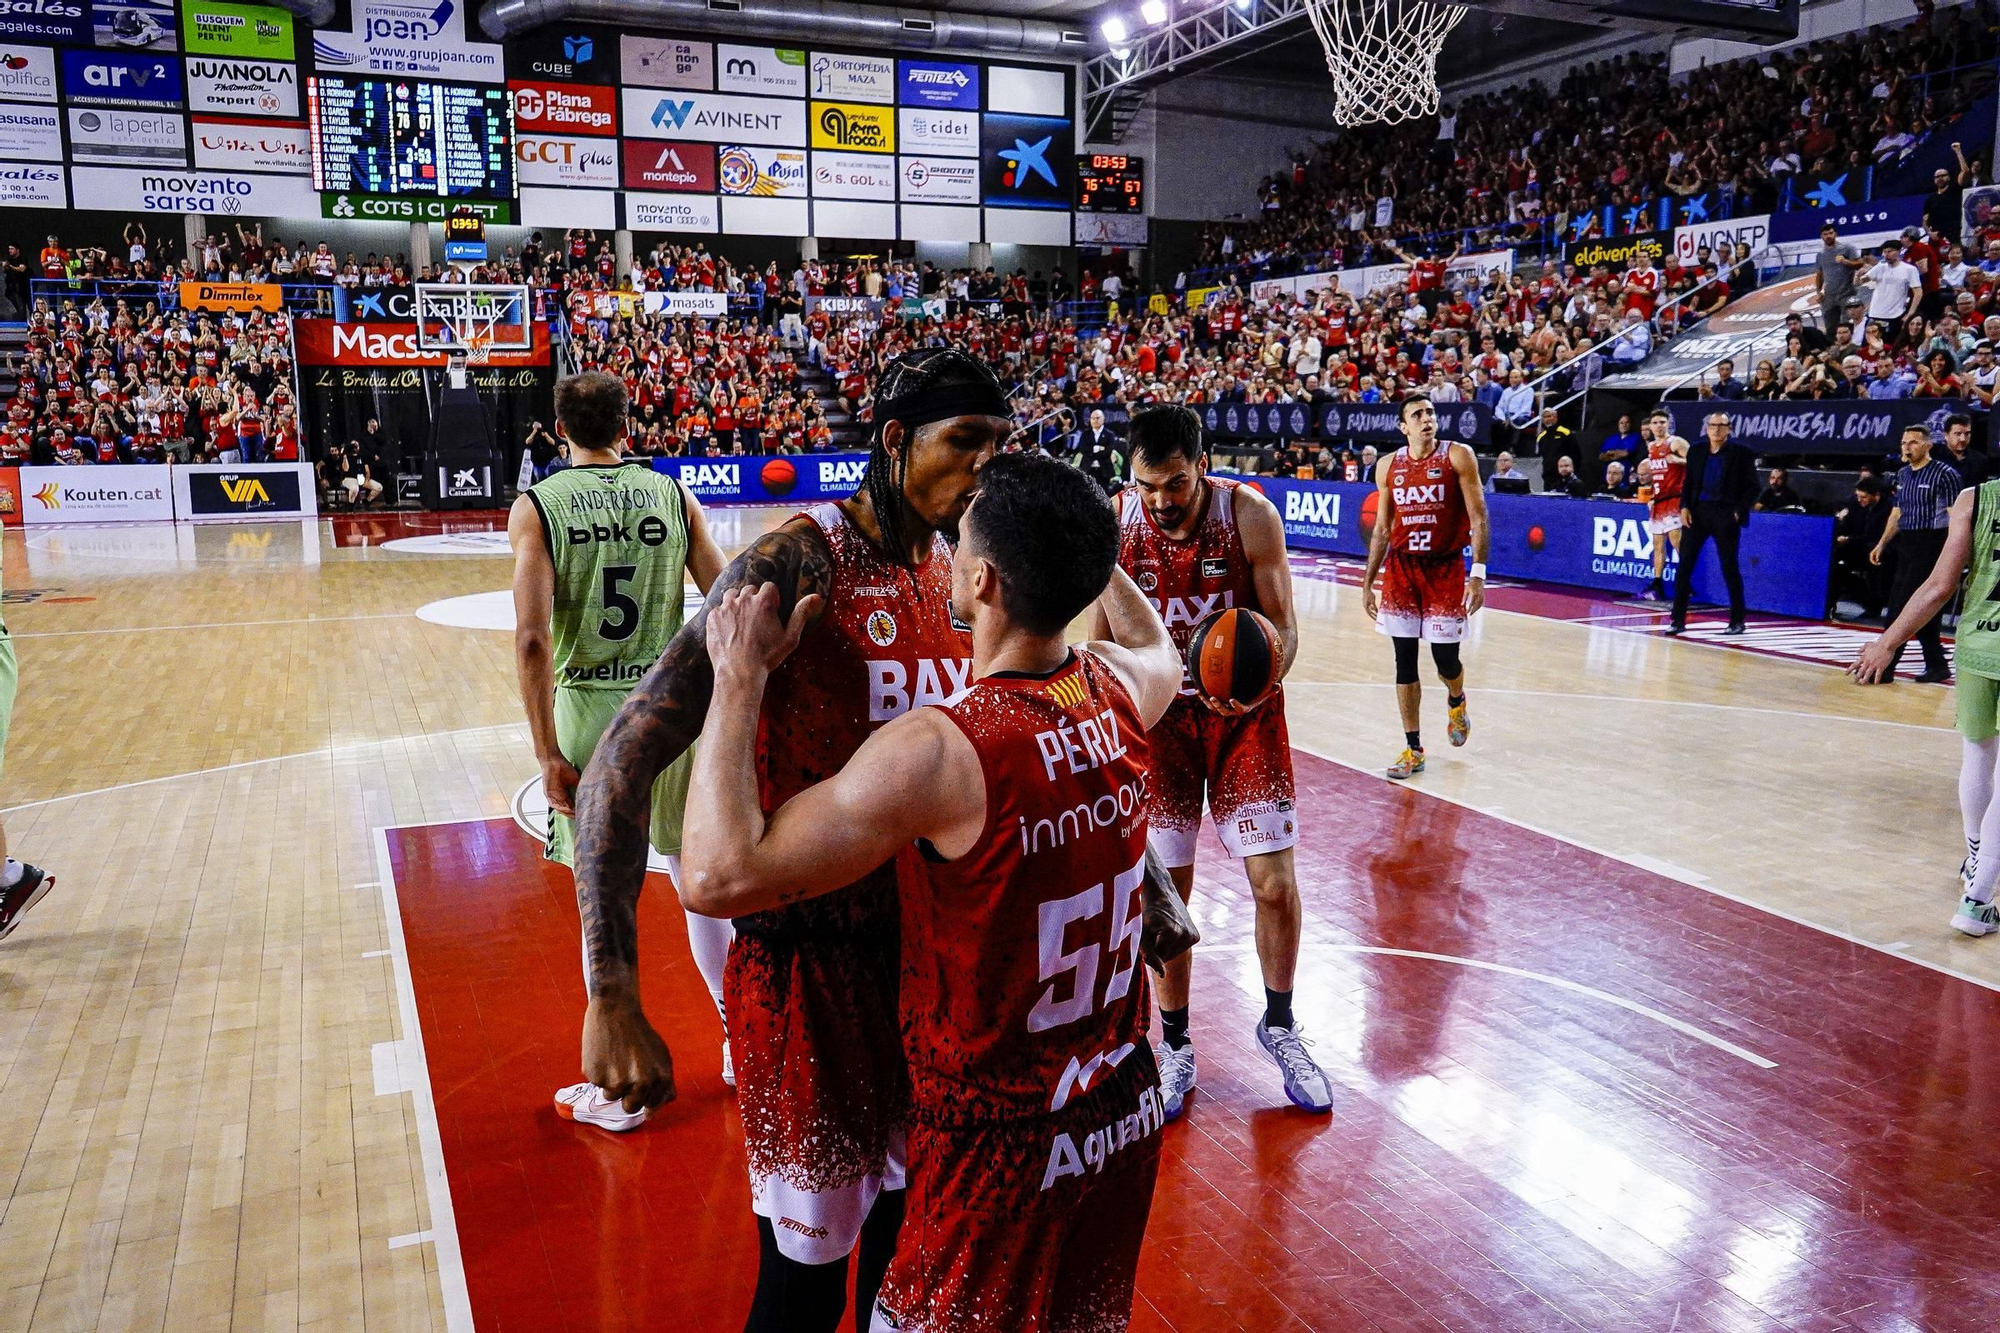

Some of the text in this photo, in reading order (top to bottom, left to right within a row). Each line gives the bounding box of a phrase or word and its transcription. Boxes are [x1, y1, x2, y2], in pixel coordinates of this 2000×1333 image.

[196, 15, 244, 25] BUSQUEM
[365, 7, 427, 19] DISTRIBUIDORA
[197, 24, 230, 32] TALENT
[198, 33, 214, 41] PER
[369, 46, 495, 64] www.grupjoan.com
[190, 62, 292, 84] JUANOLA
[532, 62, 572, 74] CUBE
[908, 69, 954, 84] PENTEX
[207, 96, 255, 106] expert
[546, 90, 592, 108] Plana
[546, 106, 612, 127] Fábrega
[694, 110, 782, 131] AVINENT
[930, 120, 968, 135] cidet
[516, 140, 612, 172] GCT plus
[1093, 156, 1126, 169] 03:53
[142, 176, 252, 196] movento
[850, 176, 875, 186] GOL
[1083, 178, 1098, 191] 76
[1124, 180, 1140, 193] 67
[144, 194, 214, 211] sarsa
[1082, 194, 1090, 204] 3
[1130, 196, 1136, 206] 5
[362, 200, 414, 215] COTS
[637, 204, 692, 215] movento
[638, 214, 672, 224] sarsa
[672, 298, 715, 309] masats
[680, 464, 740, 486] BAXI
[818, 461, 869, 482] BAX
[64, 488, 162, 501] Kouten.cat
[220, 479, 270, 502] VIA
[1392, 484, 1445, 506] BAXI
[570, 488, 658, 514] ANDERSSON
[1286, 490, 1341, 525] BAXI
[567, 522, 633, 544] bbk
[1408, 530, 1432, 550] 22
[598, 564, 640, 642] 5
[864, 658, 975, 722] BAX
[1035, 707, 1127, 782] PÉRIZ
[1238, 818, 1258, 834] ETL
[1240, 830, 1281, 846] GLOBAL
[1027, 852, 1146, 1033] 55
